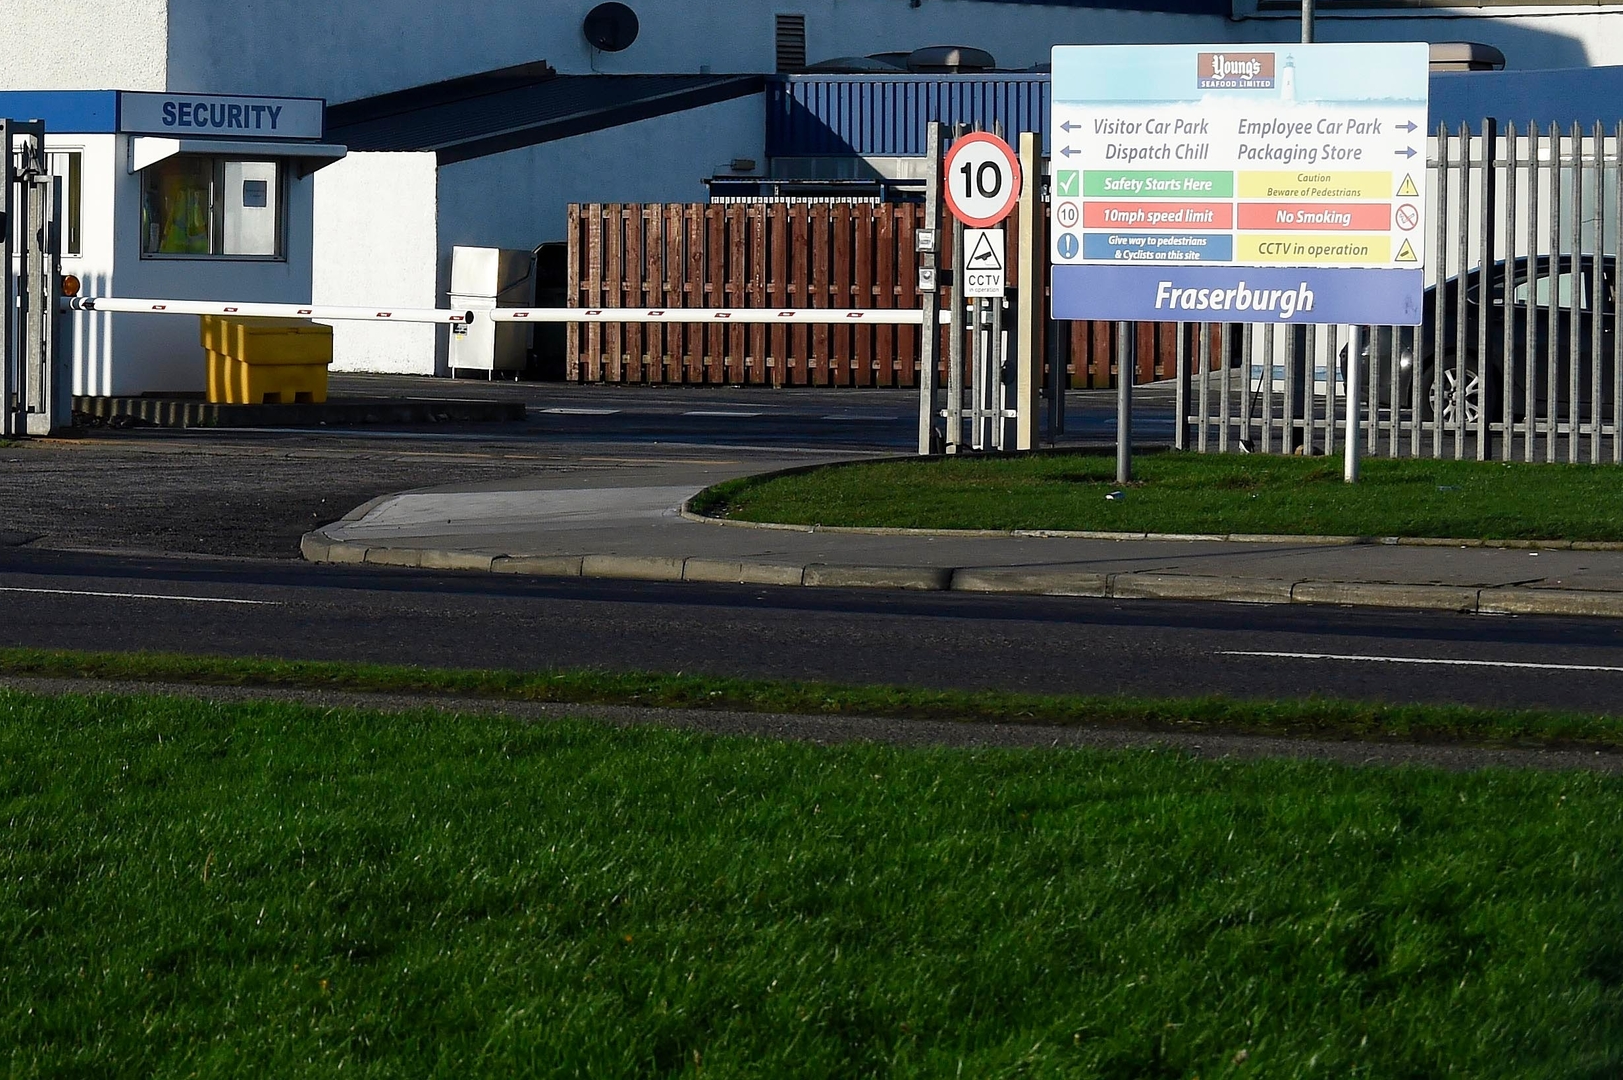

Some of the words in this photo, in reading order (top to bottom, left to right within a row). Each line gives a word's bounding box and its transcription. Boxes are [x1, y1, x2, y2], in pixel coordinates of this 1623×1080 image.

[1212, 55, 1261, 80] Young's
[162, 101, 282, 129] SECURITY
[1094, 118, 1142, 134] Visitor
[1146, 119, 1171, 134] Car
[1174, 118, 1209, 134] Park
[1238, 118, 1312, 138] Employee
[1317, 118, 1343, 134] Car
[1346, 118, 1382, 134] Park
[1106, 144, 1170, 163] Dispatch
[1176, 143, 1209, 159] Chill
[1238, 144, 1318, 164] Packaging
[1322, 144, 1362, 160] Store
[960, 161, 1002, 198] 10
[1104, 177, 1144, 193] Safety
[1145, 178, 1181, 190] Starts
[1184, 178, 1212, 190] Here
[1298, 174, 1331, 182] Caution
[1267, 188, 1298, 196] Beware
[1301, 188, 1310, 196] of
[1311, 188, 1361, 196] Pedestrians
[1061, 208, 1075, 221] 10
[1104, 208, 1145, 224] 10mph
[1147, 210, 1183, 224] speed
[1185, 209, 1214, 222] limit
[1276, 210, 1294, 223] No
[1296, 210, 1351, 226] Smoking
[1108, 236, 1127, 245] Give
[1129, 237, 1146, 246] way
[1147, 237, 1156, 245] to
[1157, 236, 1207, 247] pedestrians
[1115, 250, 1121, 259] &
[1123, 250, 1154, 260] Cyclists
[1168, 250, 1184, 259] this
[1184, 251, 1200, 260] site
[1258, 242, 1291, 254] CCTV
[1294, 243, 1304, 254] in
[1308, 244, 1368, 258] operation
[969, 275, 1000, 285] CCTV
[1154, 281, 1315, 319] Fraserburgh
